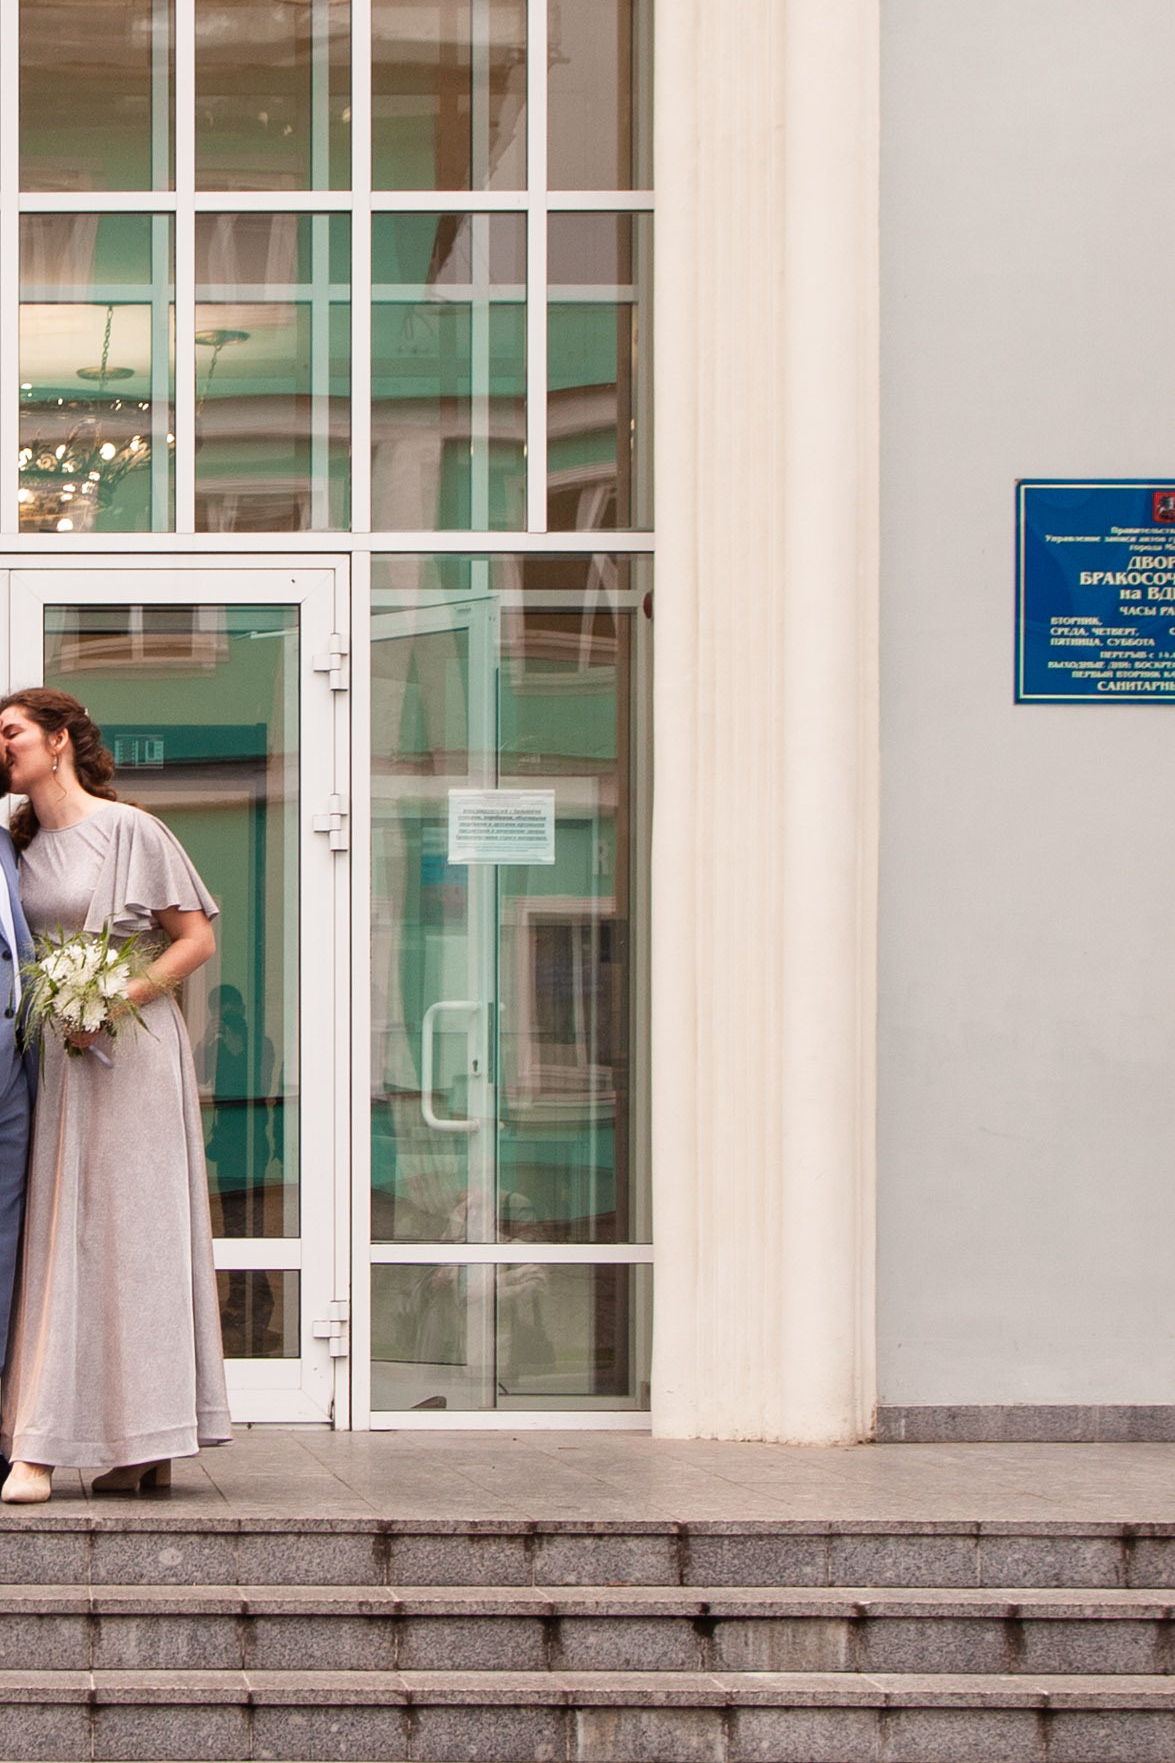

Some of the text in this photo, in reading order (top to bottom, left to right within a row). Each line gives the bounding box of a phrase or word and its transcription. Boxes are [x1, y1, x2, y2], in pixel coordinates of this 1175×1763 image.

[1127, 556, 1175, 570] ДВОР
[1080, 571, 1175, 586] БРАКОСОЧ
[1120, 589, 1142, 600] на
[1119, 606, 1157, 616] ЧАСЫ
[1050, 617, 1103, 625] ВТОРНИК,
[1050, 627, 1090, 636] СРЕДА,
[1107, 637, 1155, 647] СУББОТА
[1100, 651, 1147, 659] ПЕРЕРЫВ
[1048, 661, 1105, 670] ВЫХОДНЫЕ
[1071, 670, 1114, 678] ПЕРВЫЙ
